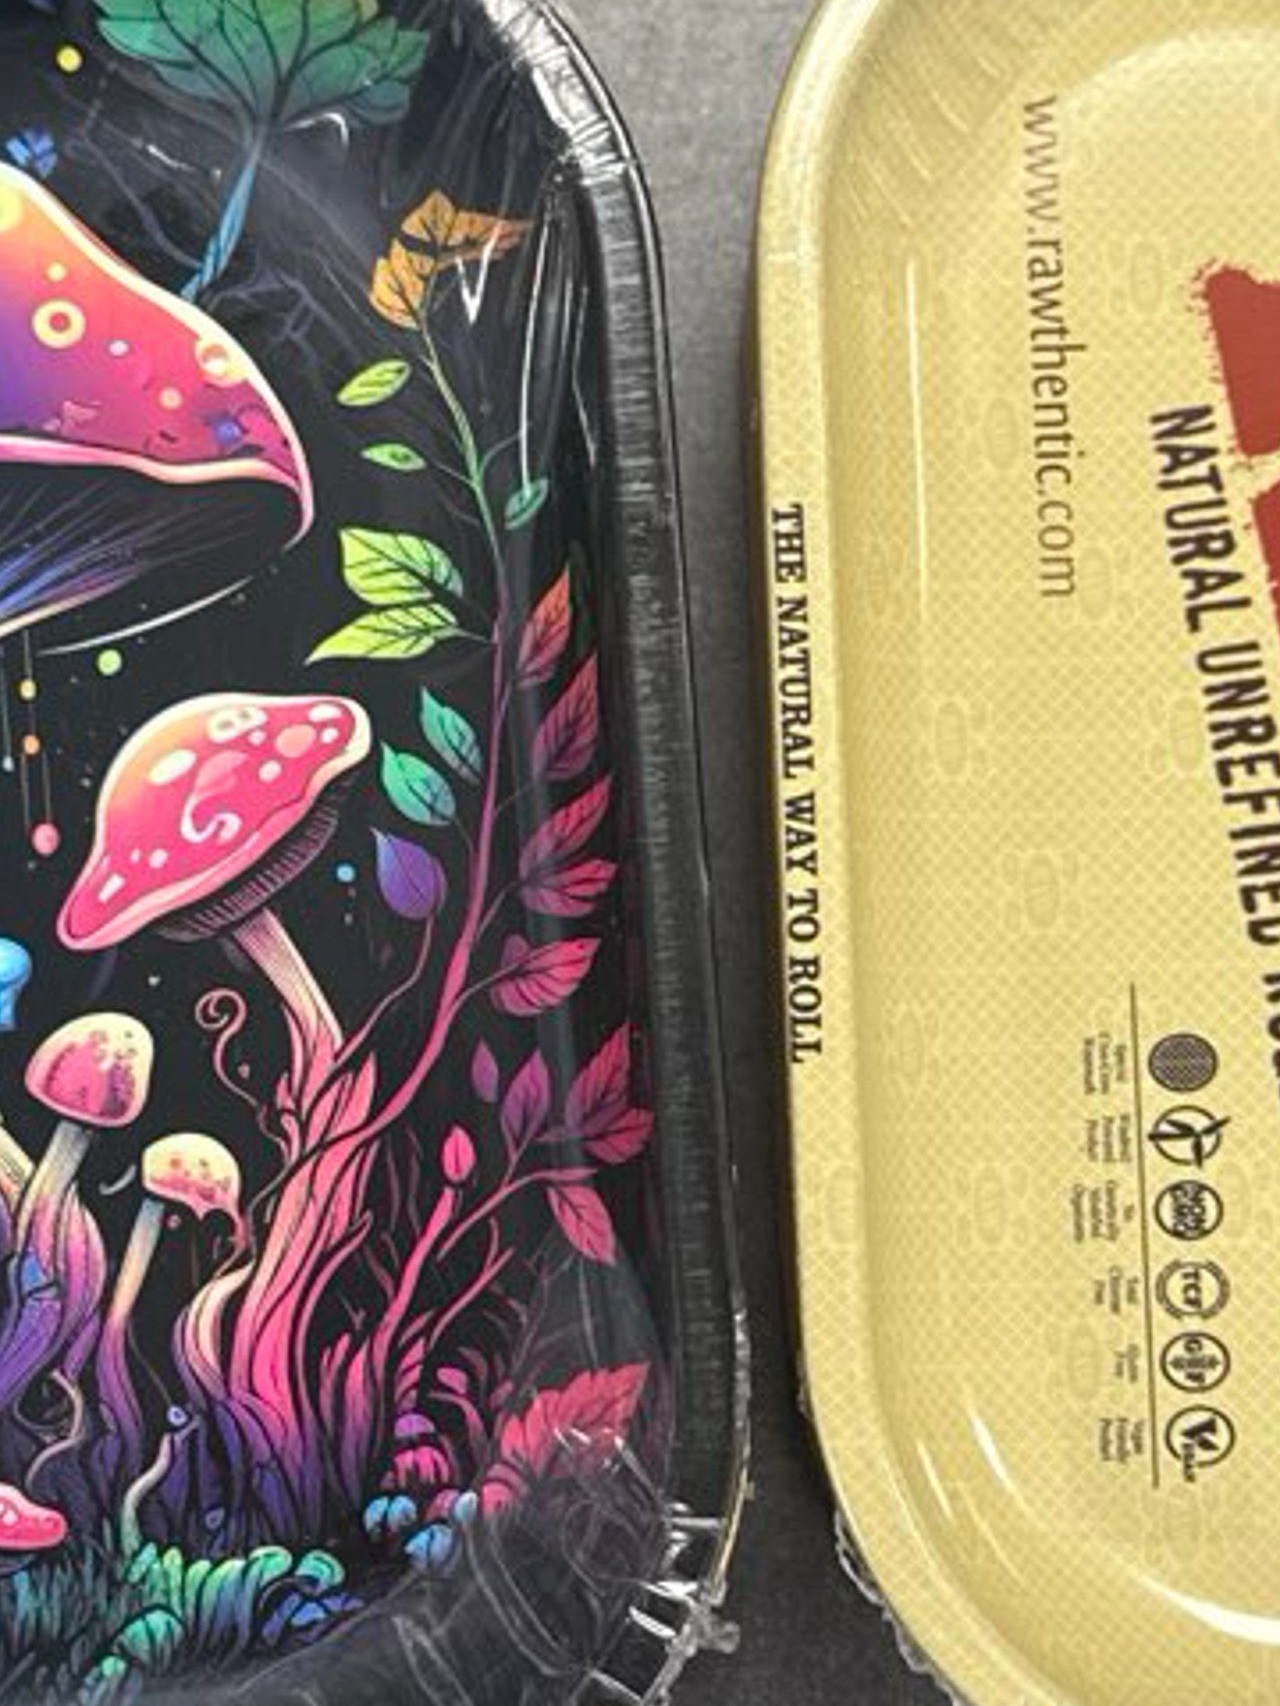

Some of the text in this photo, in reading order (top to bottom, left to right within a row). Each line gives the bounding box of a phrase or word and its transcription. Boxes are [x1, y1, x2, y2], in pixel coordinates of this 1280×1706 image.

[1022, 94, 1086, 599] www.rawthentic.com
[1148, 404, 1247, 633] NATURAL
[771, 503, 821, 1064] THE NATURAL WAY TO ROLL
[1181, 1269, 1202, 1310] TCF
